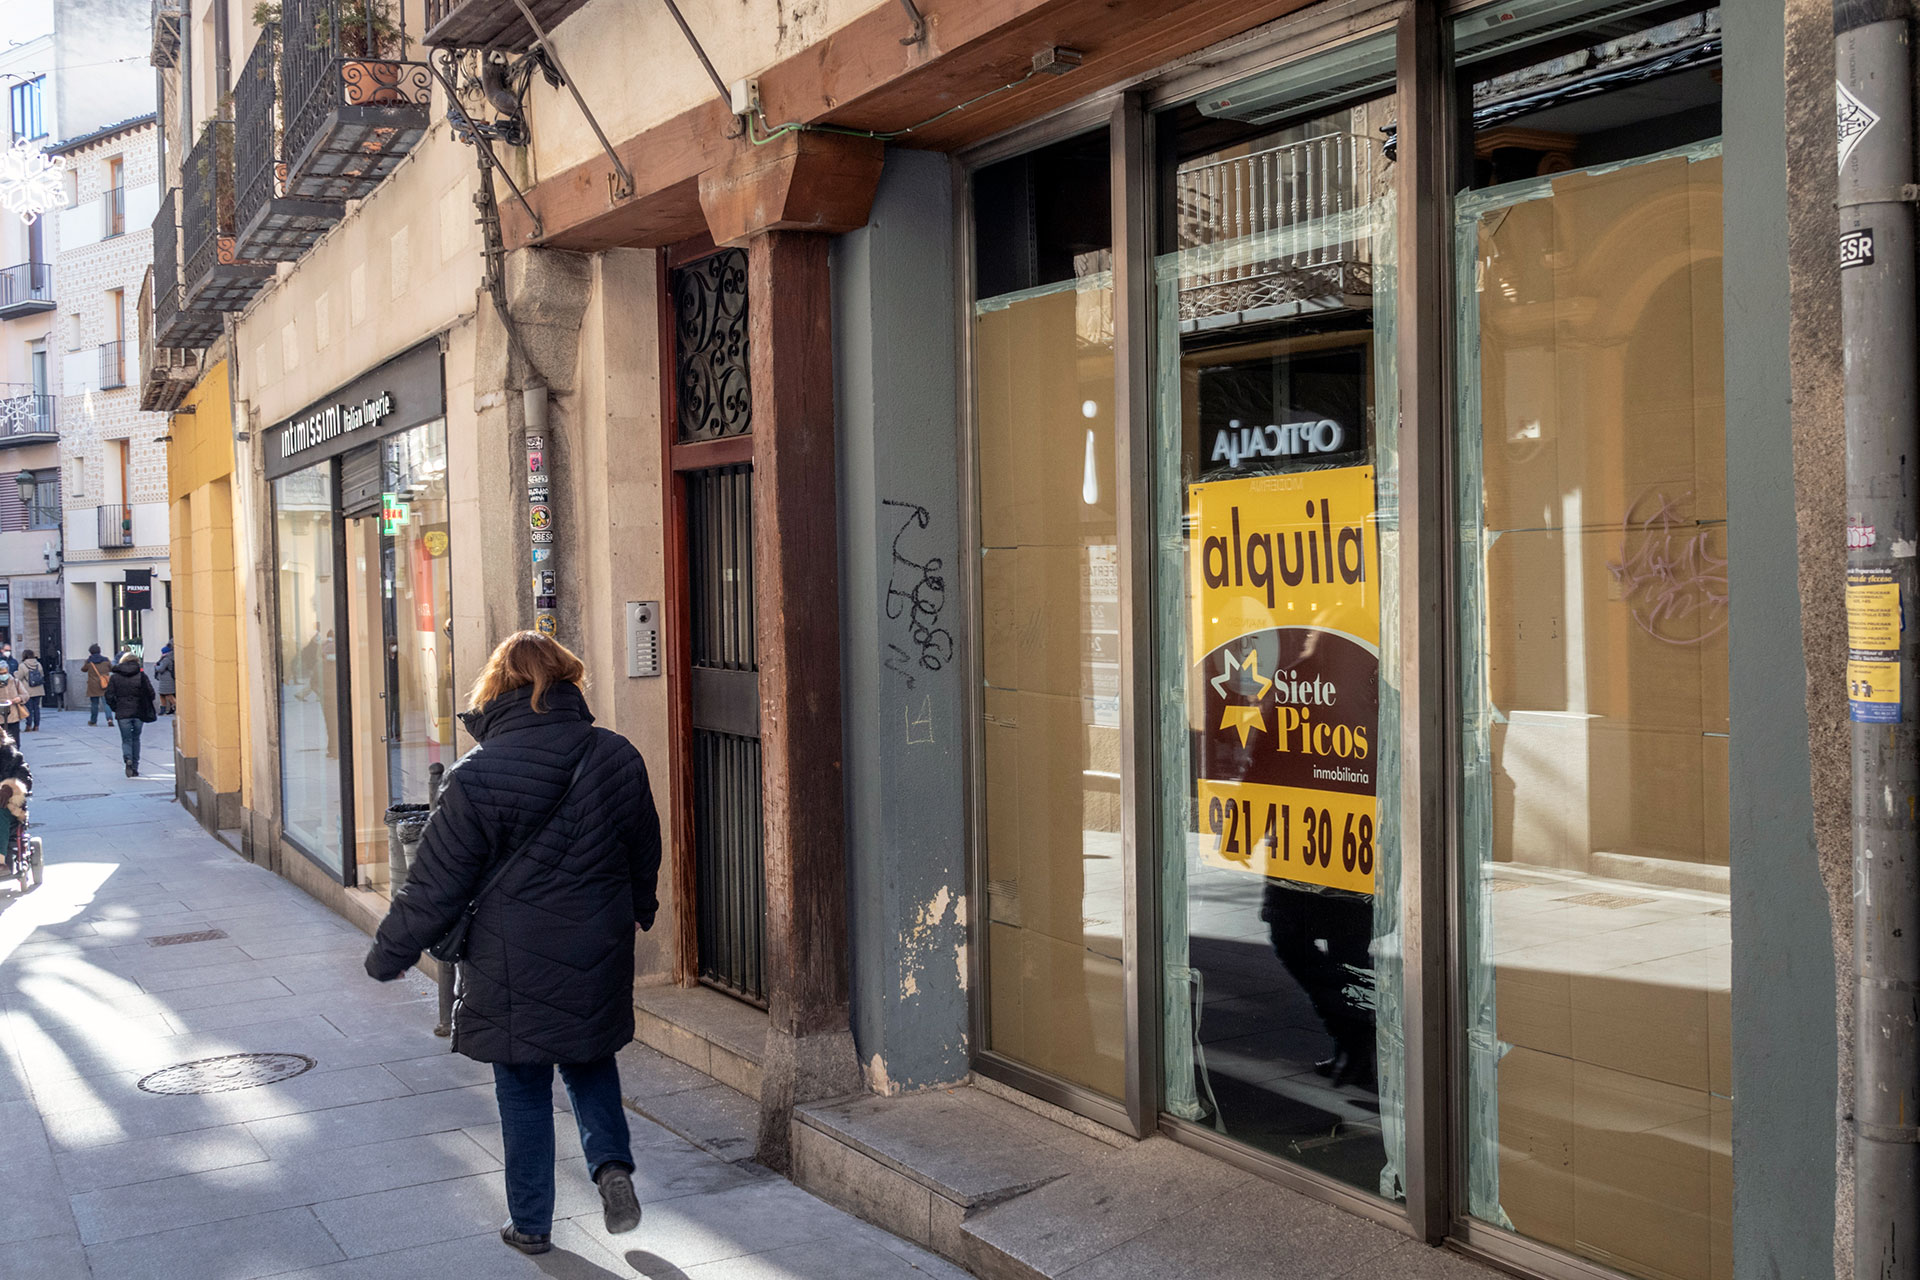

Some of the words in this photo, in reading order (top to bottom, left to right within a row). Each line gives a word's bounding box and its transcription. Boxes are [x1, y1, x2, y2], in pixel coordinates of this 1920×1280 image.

[281, 404, 341, 458] intimissimi
[363, 391, 391, 427] lingerie
[1202, 499, 1366, 609] alquila
[1868, 575, 1893, 583] Acceso
[1274, 669, 1336, 706] Siete
[1275, 706, 1368, 760] Picos
[1313, 764, 1369, 785] inmobiliaria
[1209, 796, 1252, 856] 921
[1264, 803, 1291, 861] 41
[1302, 806, 1333, 869] 30
[1342, 812, 1374, 876] 68
